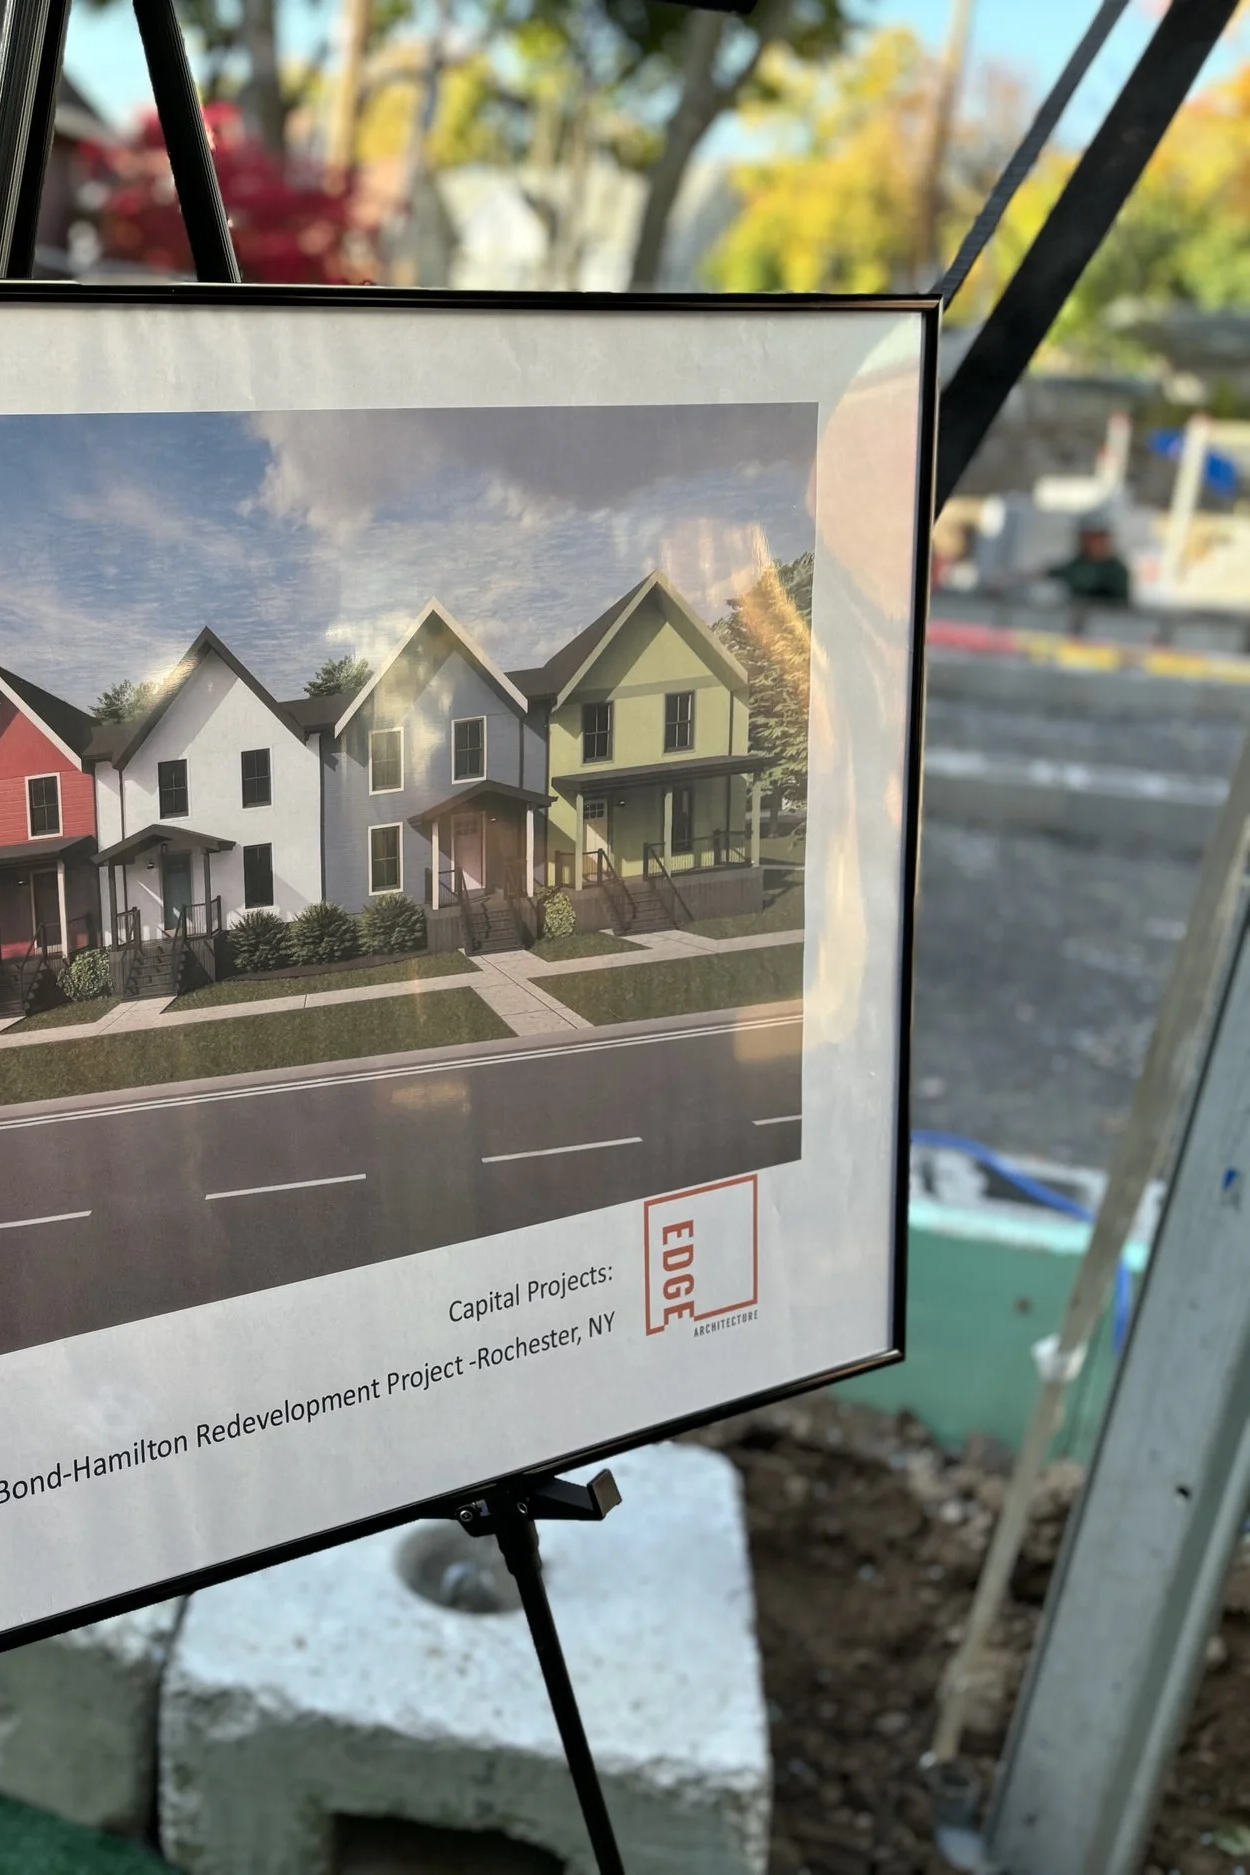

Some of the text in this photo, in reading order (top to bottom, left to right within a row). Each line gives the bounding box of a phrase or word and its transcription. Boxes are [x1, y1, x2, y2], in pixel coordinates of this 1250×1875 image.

[449, 1263, 614, 1325] Capital Projects:
[662, 1220, 695, 1326] EDGE
[693, 1309, 759, 1338] ARCHITECTURE
[196, 1379, 381, 1449] Redevelopment
[386, 1356, 465, 1396] Project
[468, 1323, 584, 1371] -Rochester,
[588, 1311, 617, 1337] NY
